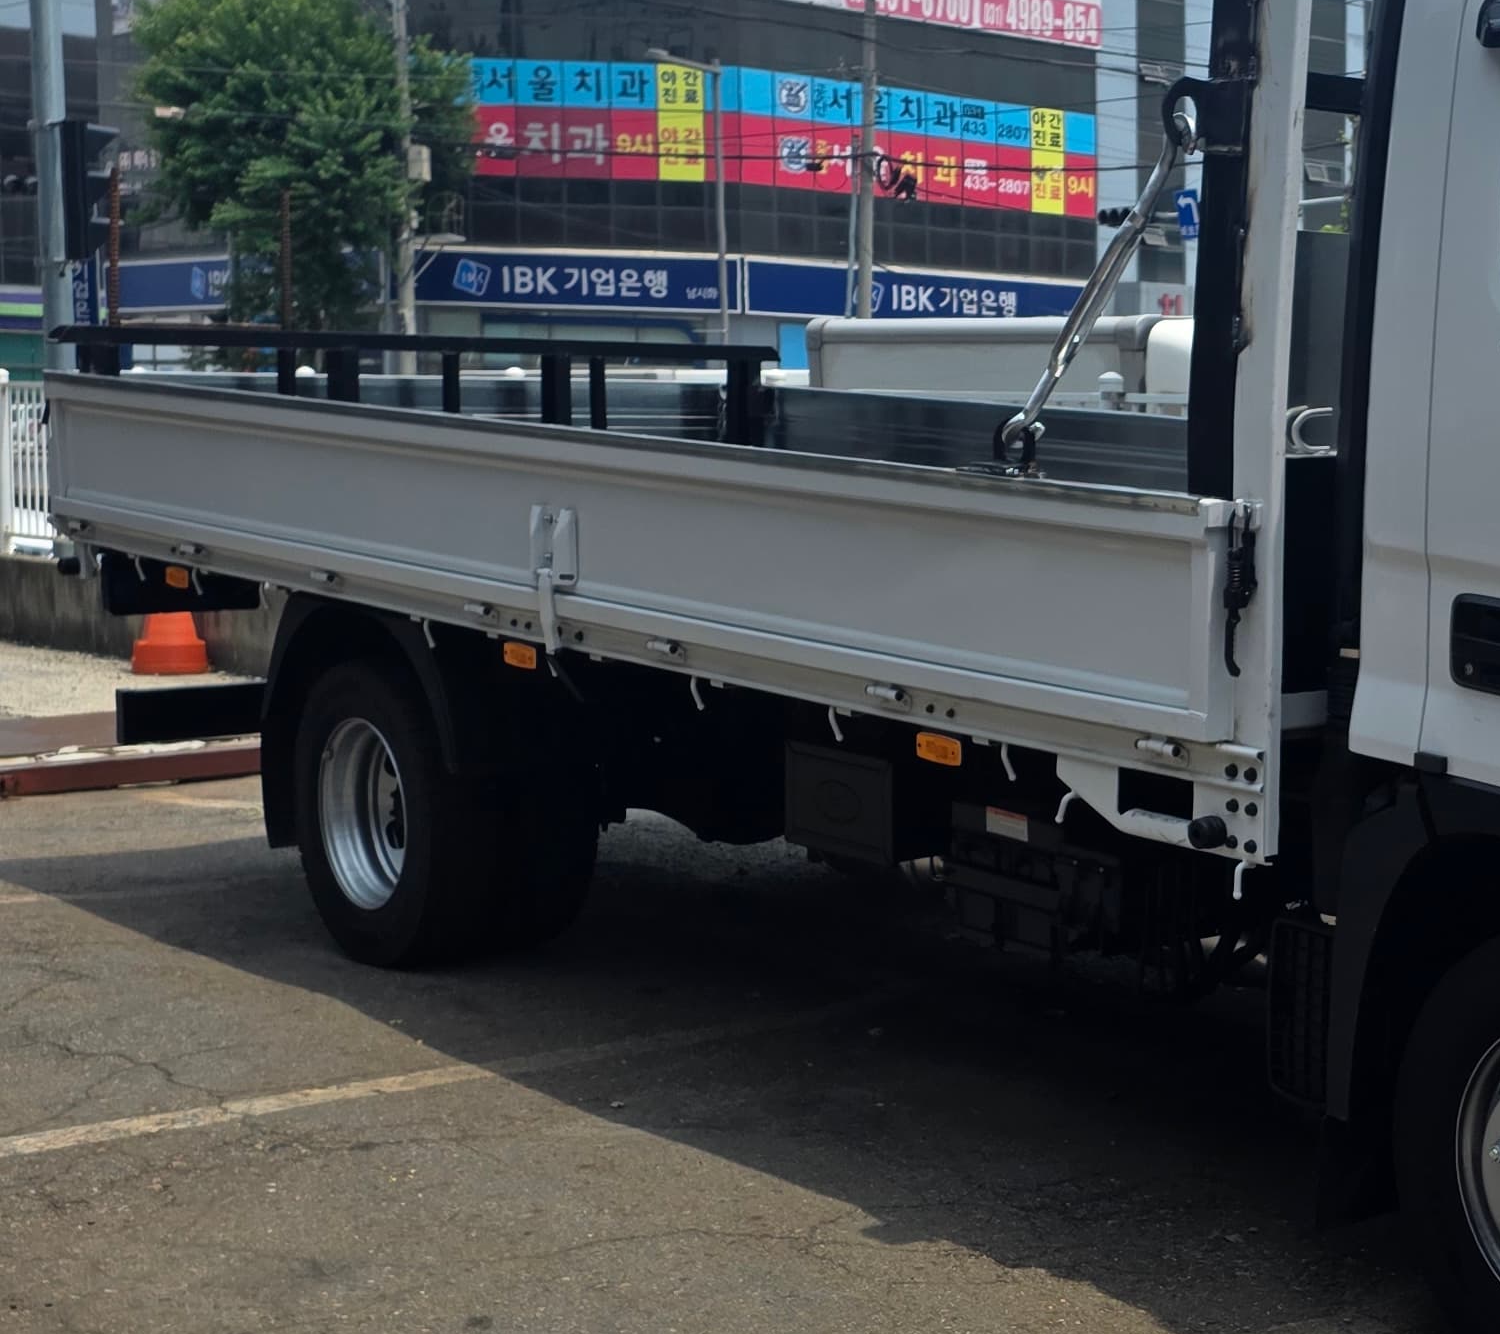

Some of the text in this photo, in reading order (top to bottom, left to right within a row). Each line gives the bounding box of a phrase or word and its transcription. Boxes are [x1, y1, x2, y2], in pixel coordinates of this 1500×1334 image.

[487, 65, 648, 103] 서울치과
[962, 119, 1029, 141] 433 2807
[1032, 111, 1062, 130] 야간
[1068, 176, 1093, 198] 9시
[502, 265, 557, 295] IBK
[564, 267, 669, 298] 기업은행
[892, 284, 934, 312] IBK
[940, 287, 1017, 317] 기업은행
